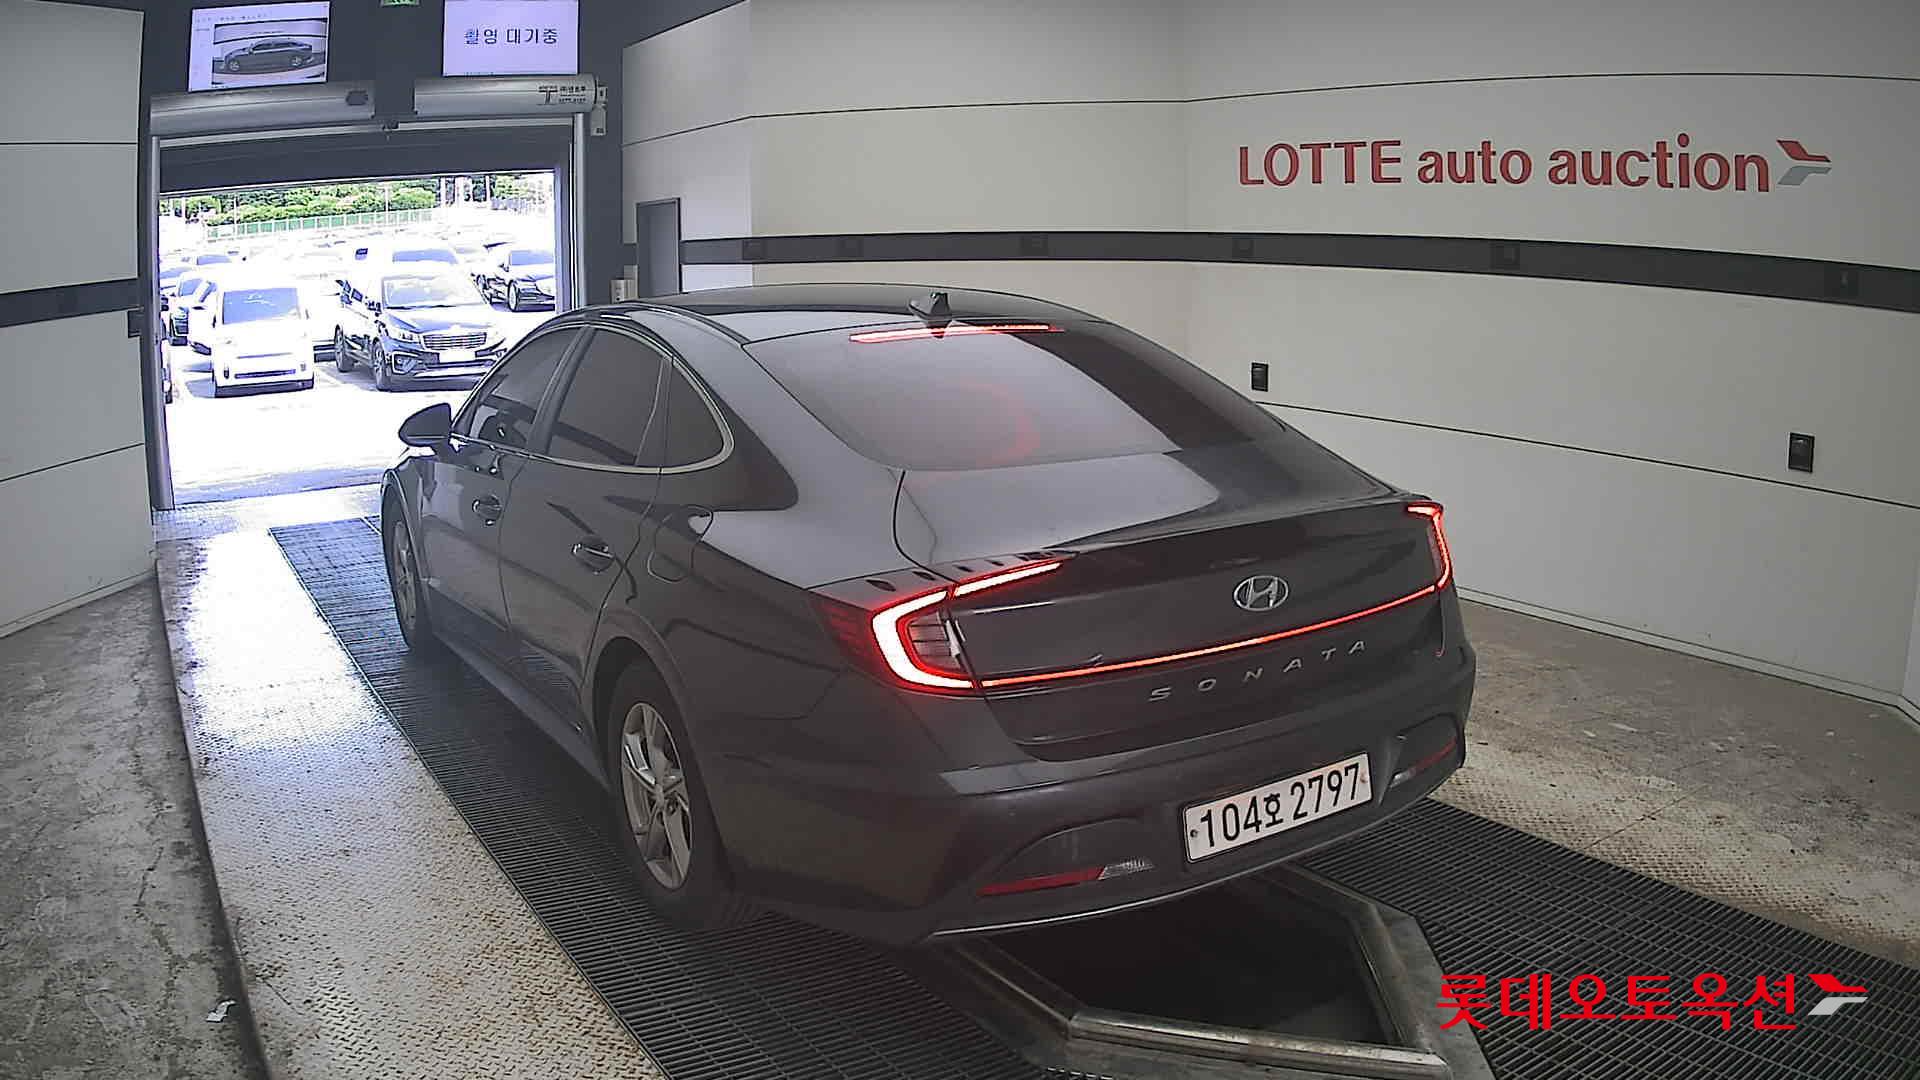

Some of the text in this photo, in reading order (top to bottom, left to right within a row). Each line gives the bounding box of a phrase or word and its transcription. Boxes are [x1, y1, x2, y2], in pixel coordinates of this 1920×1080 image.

[506, 28, 558, 45] 대기중
[1238, 133, 1770, 193] LOTTE auto auction
[1149, 639, 1367, 702] SONATA
[1289, 763, 1361, 822] 2797
